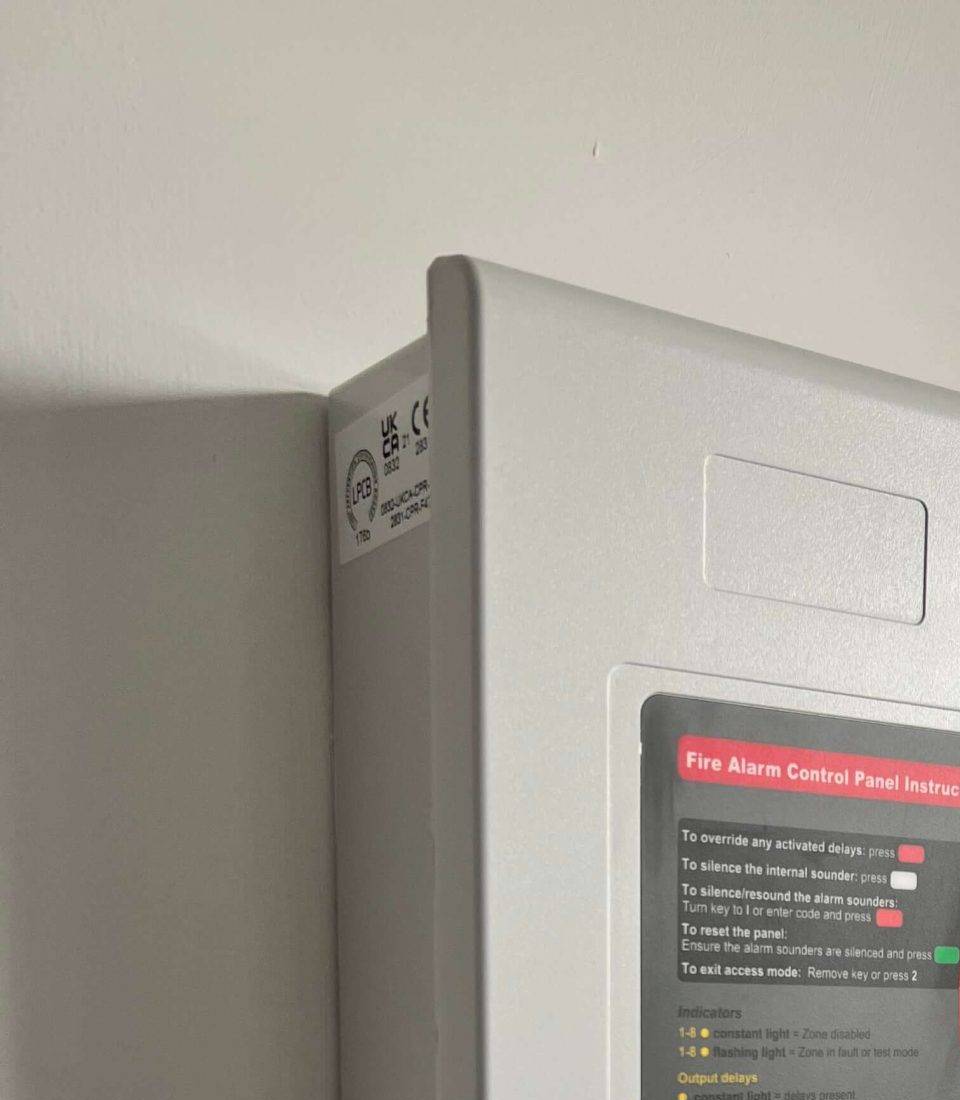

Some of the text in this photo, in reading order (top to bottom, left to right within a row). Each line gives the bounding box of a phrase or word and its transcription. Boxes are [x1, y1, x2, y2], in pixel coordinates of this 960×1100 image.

[381, 411, 397, 437] UK
[382, 433, 399, 459] CA
[352, 476, 372, 505] LPCB
[686, 751, 722, 771] Fire
[728, 756, 781, 778] Alarm
[787, 763, 849, 785] Control
[855, 770, 899, 791] Panel
[682, 829, 896, 858] To override any activated delays: press
[682, 858, 888, 884] To silence the internal sounder: press
[682, 883, 898, 908] To silence/resound the alarm sounders:
[683, 900, 708, 913] Turn
[711, 902, 730, 917] key
[733, 904, 743, 915] to
[752, 906, 764, 917] or
[766, 907, 793, 918] enter
[795, 909, 820, 920] code
[823, 910, 841, 920] and
[845, 911, 872, 922] press
[681, 923, 788, 940] To reset the panel:
[681, 939, 932, 962] Ensure the alarm sounders are silenced and press
[681, 962, 697, 974] To
[700, 963, 722, 975] exit
[724, 966, 764, 977] access
[767, 966, 801, 978] mode:
[808, 967, 848, 979] Remove
[851, 968, 869, 982] key
[871, 971, 880, 980] or
[883, 972, 909, 982] press
[677, 1006, 743, 1019] Indicators
[679, 1026, 871, 1041] 1-8 constant light Zone disabled
[713, 1047, 759, 1060] flashing
[762, 1046, 786, 1060] light
[798, 1047, 824, 1058] Zone
[827, 1047, 835, 1057] in
[838, 1046, 859, 1058] fault
[861, 1048, 871, 1058] or
[874, 1048, 891, 1058] test
[893, 1047, 920, 1058] mode
[677, 1072, 759, 1085] Output delays
